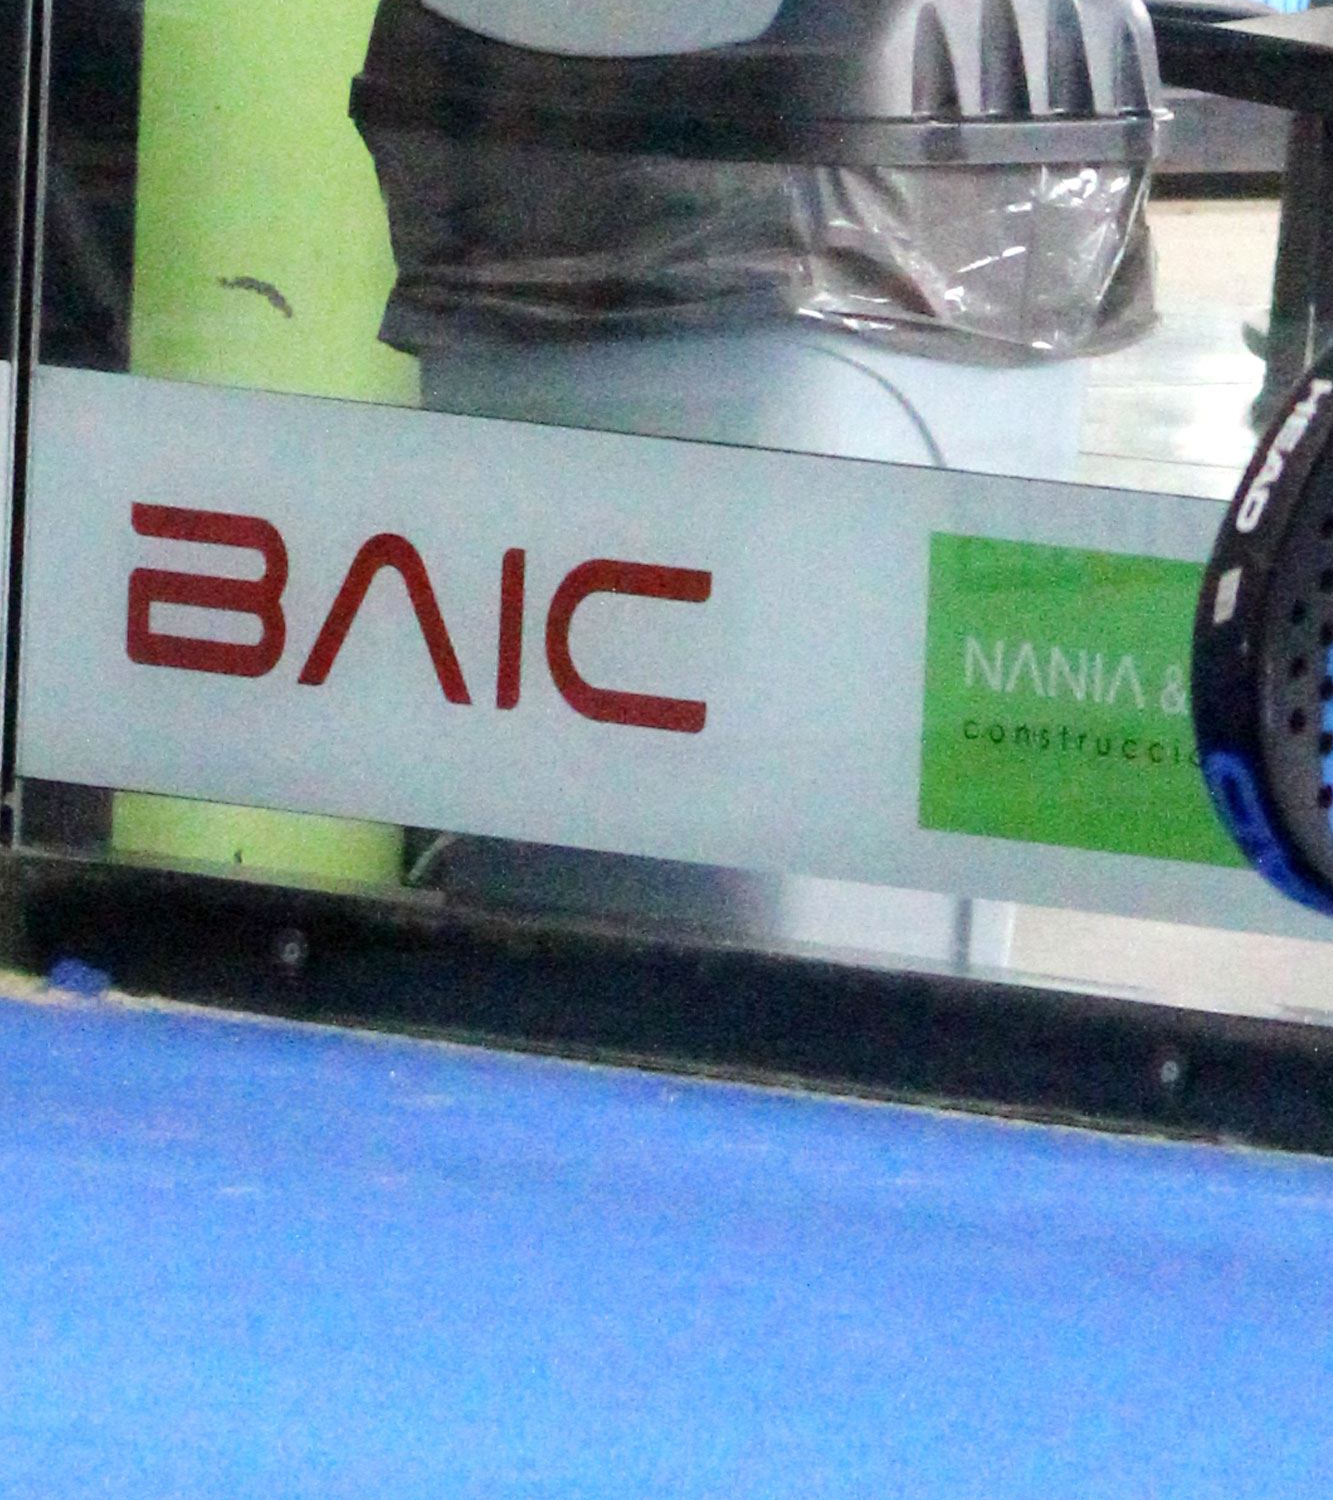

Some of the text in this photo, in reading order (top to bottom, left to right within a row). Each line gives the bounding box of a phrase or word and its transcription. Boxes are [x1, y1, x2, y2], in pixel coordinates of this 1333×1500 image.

[1235, 378, 1333, 533] HEAD
[126, 501, 713, 734] BAIC
[965, 635, 1146, 709] NANIA
